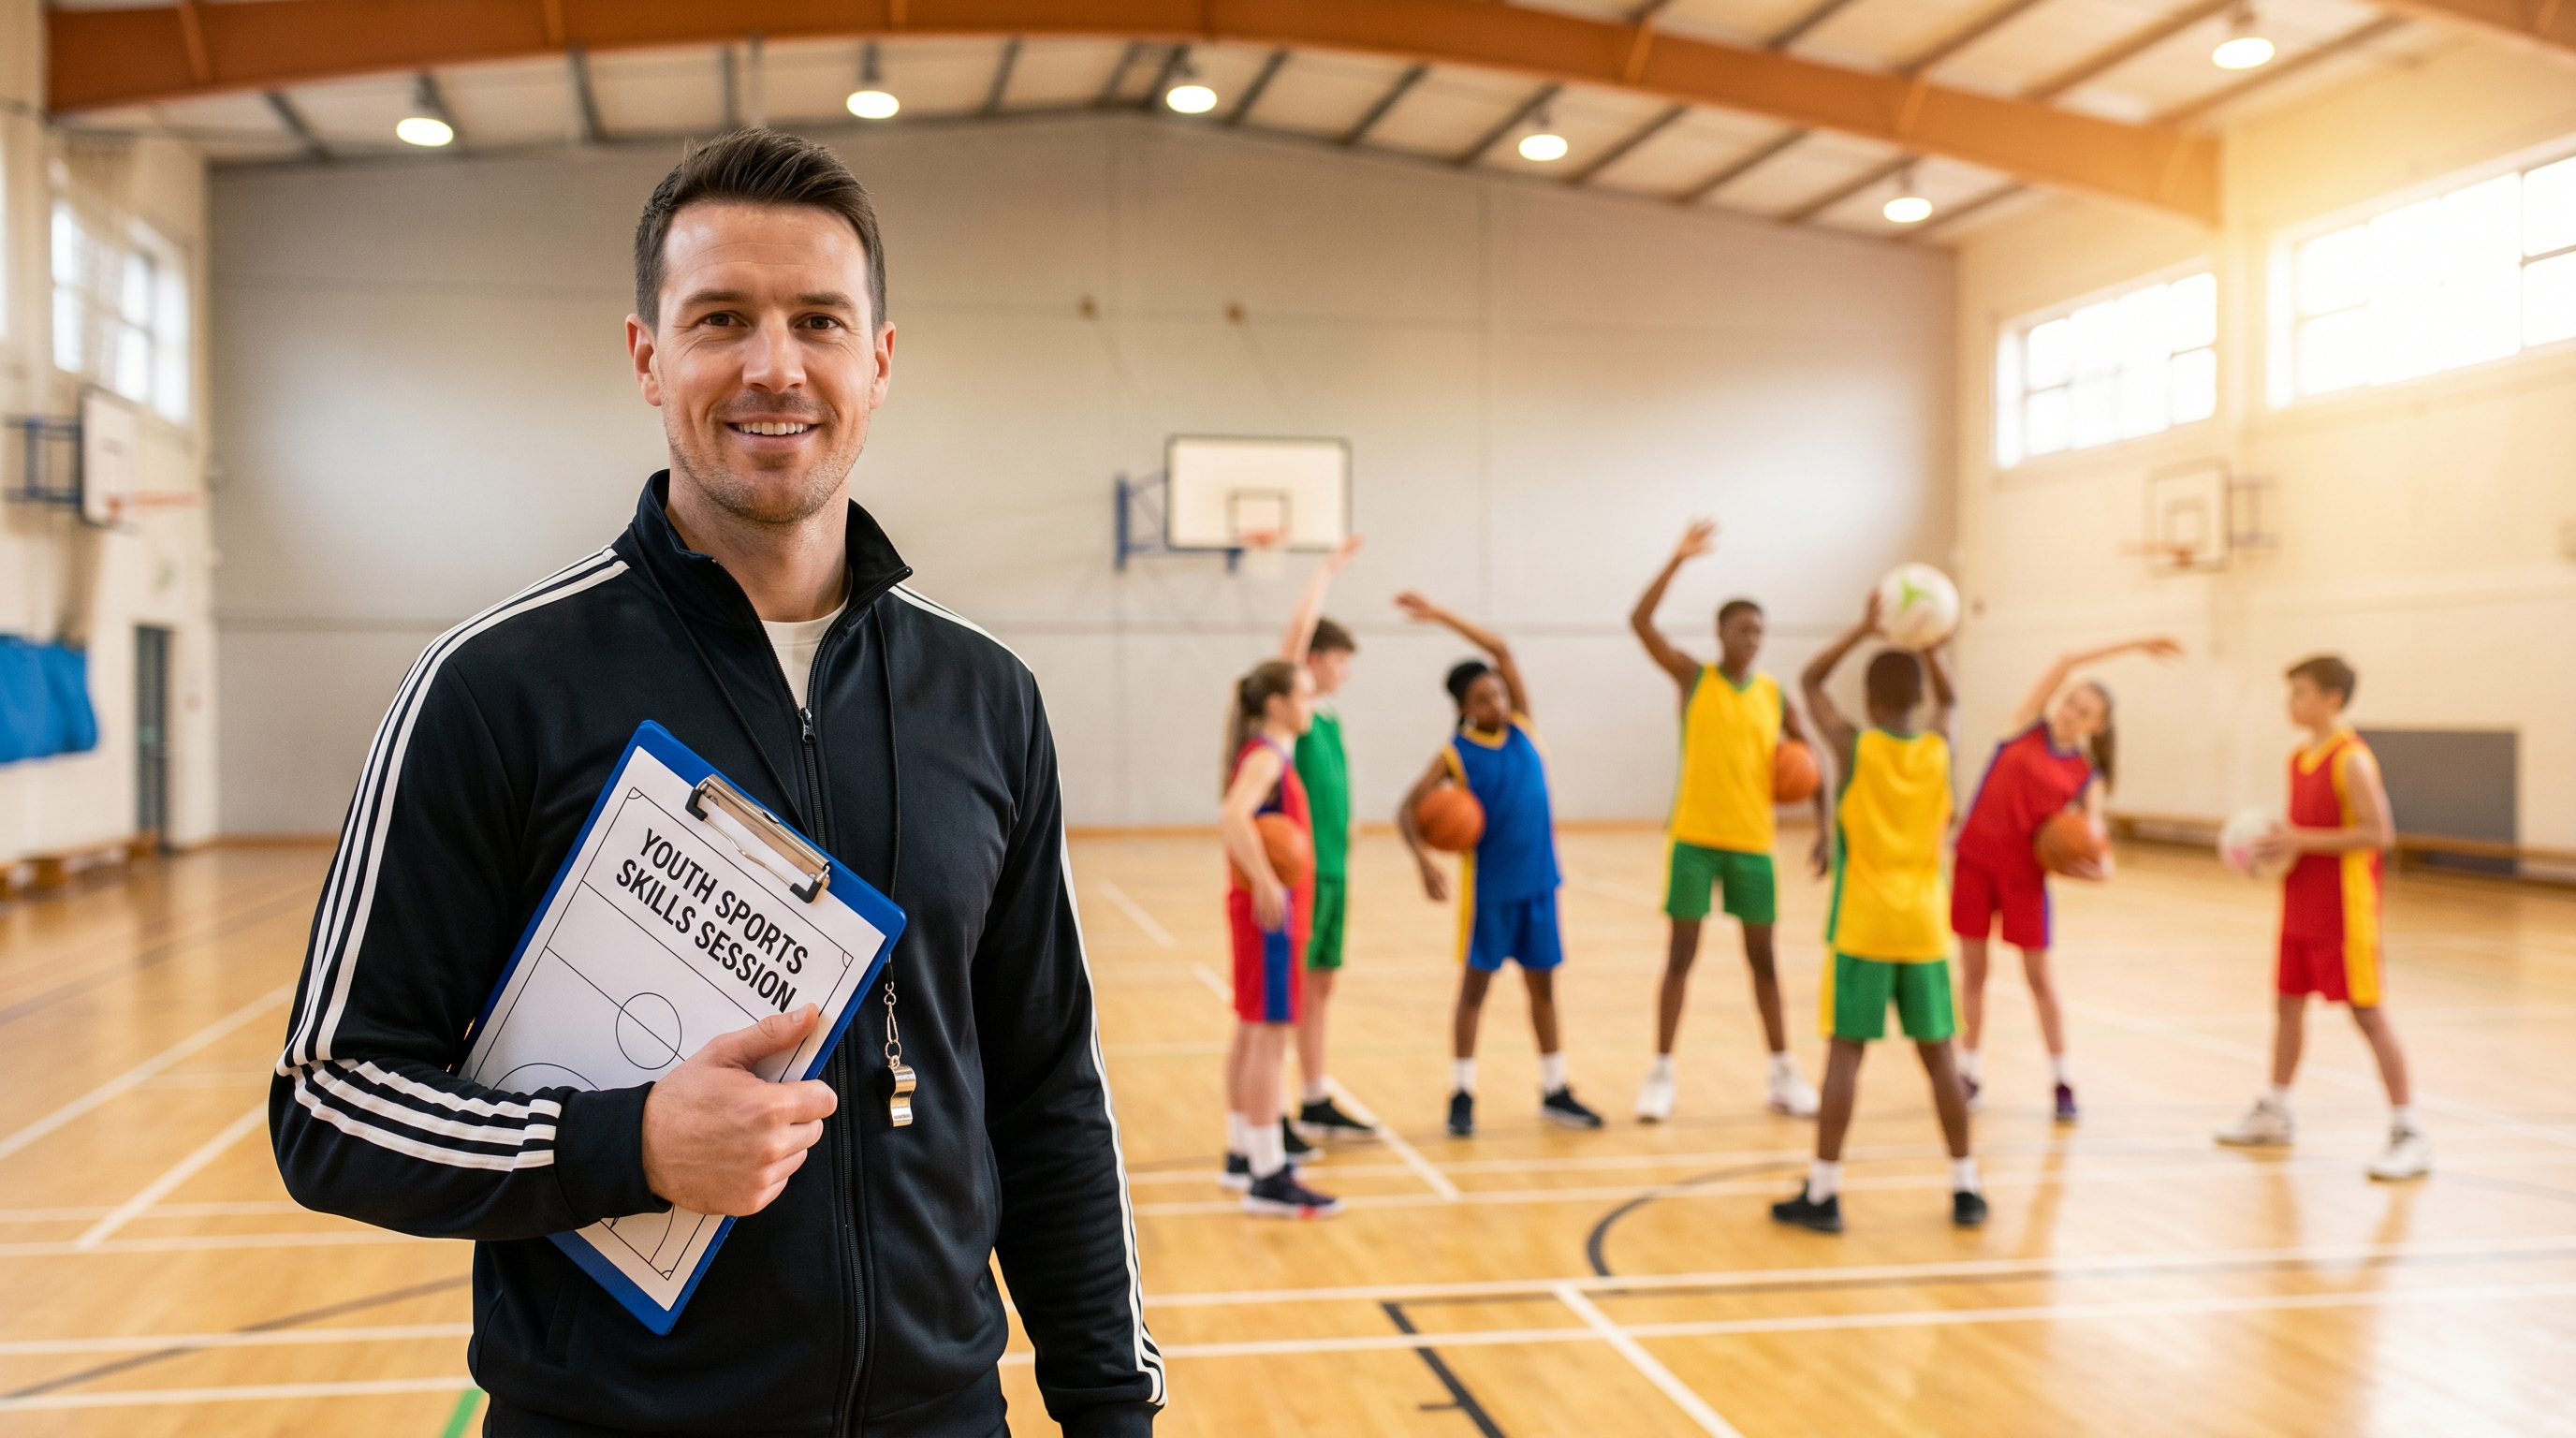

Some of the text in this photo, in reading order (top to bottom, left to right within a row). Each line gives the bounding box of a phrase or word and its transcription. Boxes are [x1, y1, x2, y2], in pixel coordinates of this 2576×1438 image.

[616, 858, 797, 1013] SKILLS SESSION
[640, 828, 808, 975] YOUTH SPORTS
